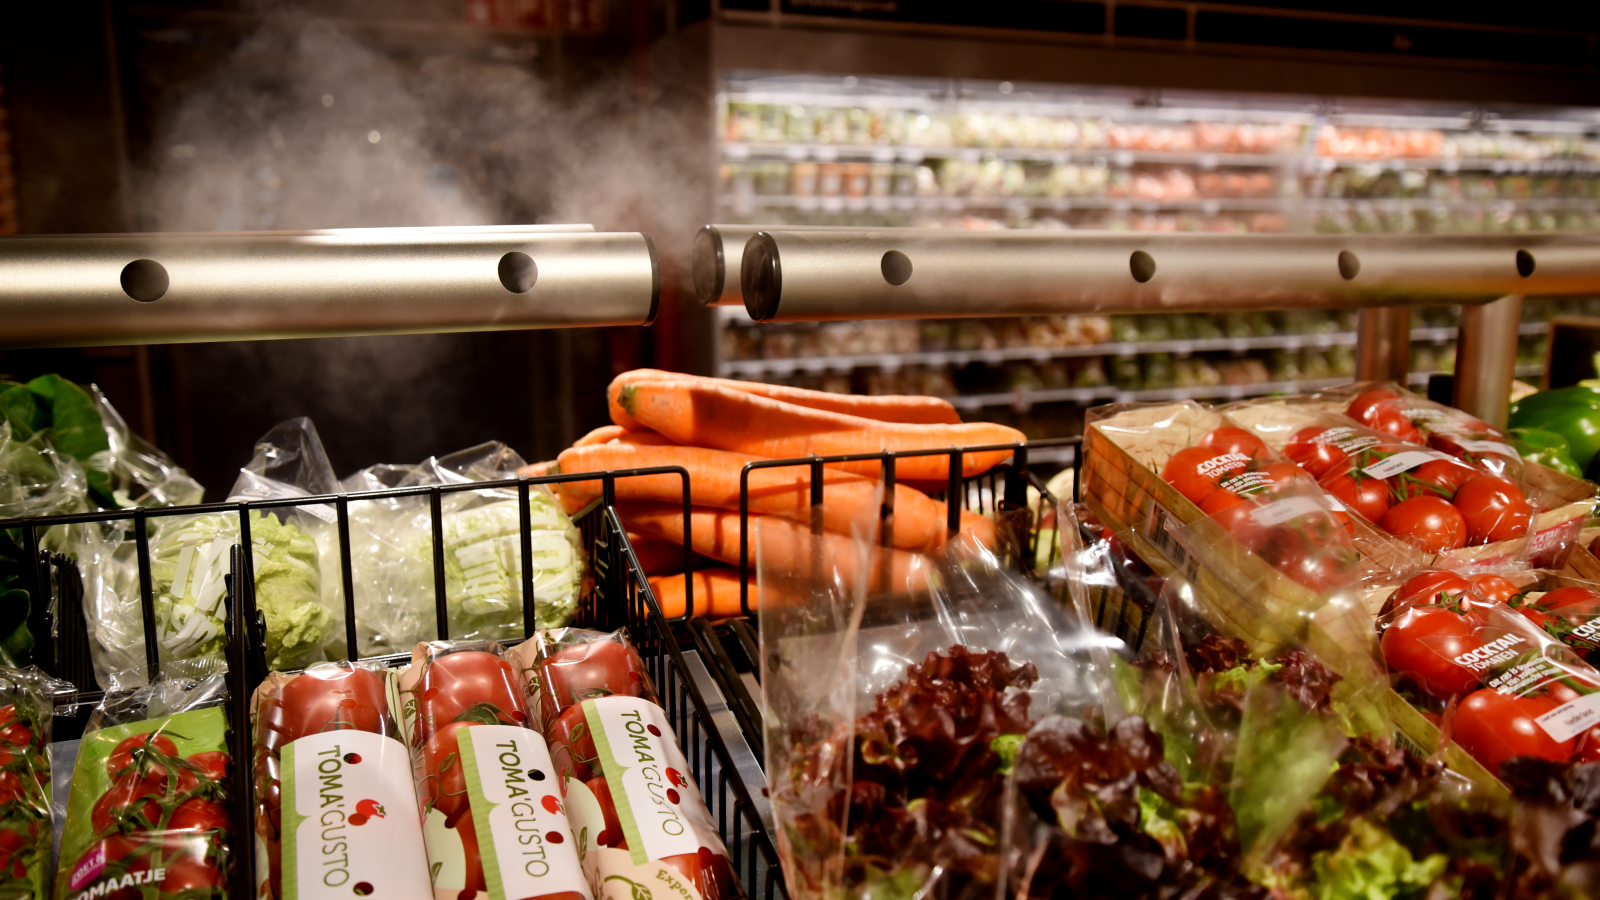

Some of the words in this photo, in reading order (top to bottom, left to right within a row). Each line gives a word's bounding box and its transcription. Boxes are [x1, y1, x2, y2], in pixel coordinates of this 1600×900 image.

[1196, 452, 1253, 475] COCKTAIL
[1205, 461, 1247, 479] TOMATEN
[1454, 633, 1526, 665] COCKTAIL
[1467, 648, 1519, 672] TOMATEN
[1488, 678, 1502, 688] Dit
[1500, 671, 1513, 682] ras
[1509, 667, 1518, 677] is
[1507, 677, 1521, 688] zijn
[317, 744, 349, 887] TOMA'GUSTO
[496, 740, 549, 877] TOMA'GUSTO
[72, 867, 166, 900] OMAATJE
